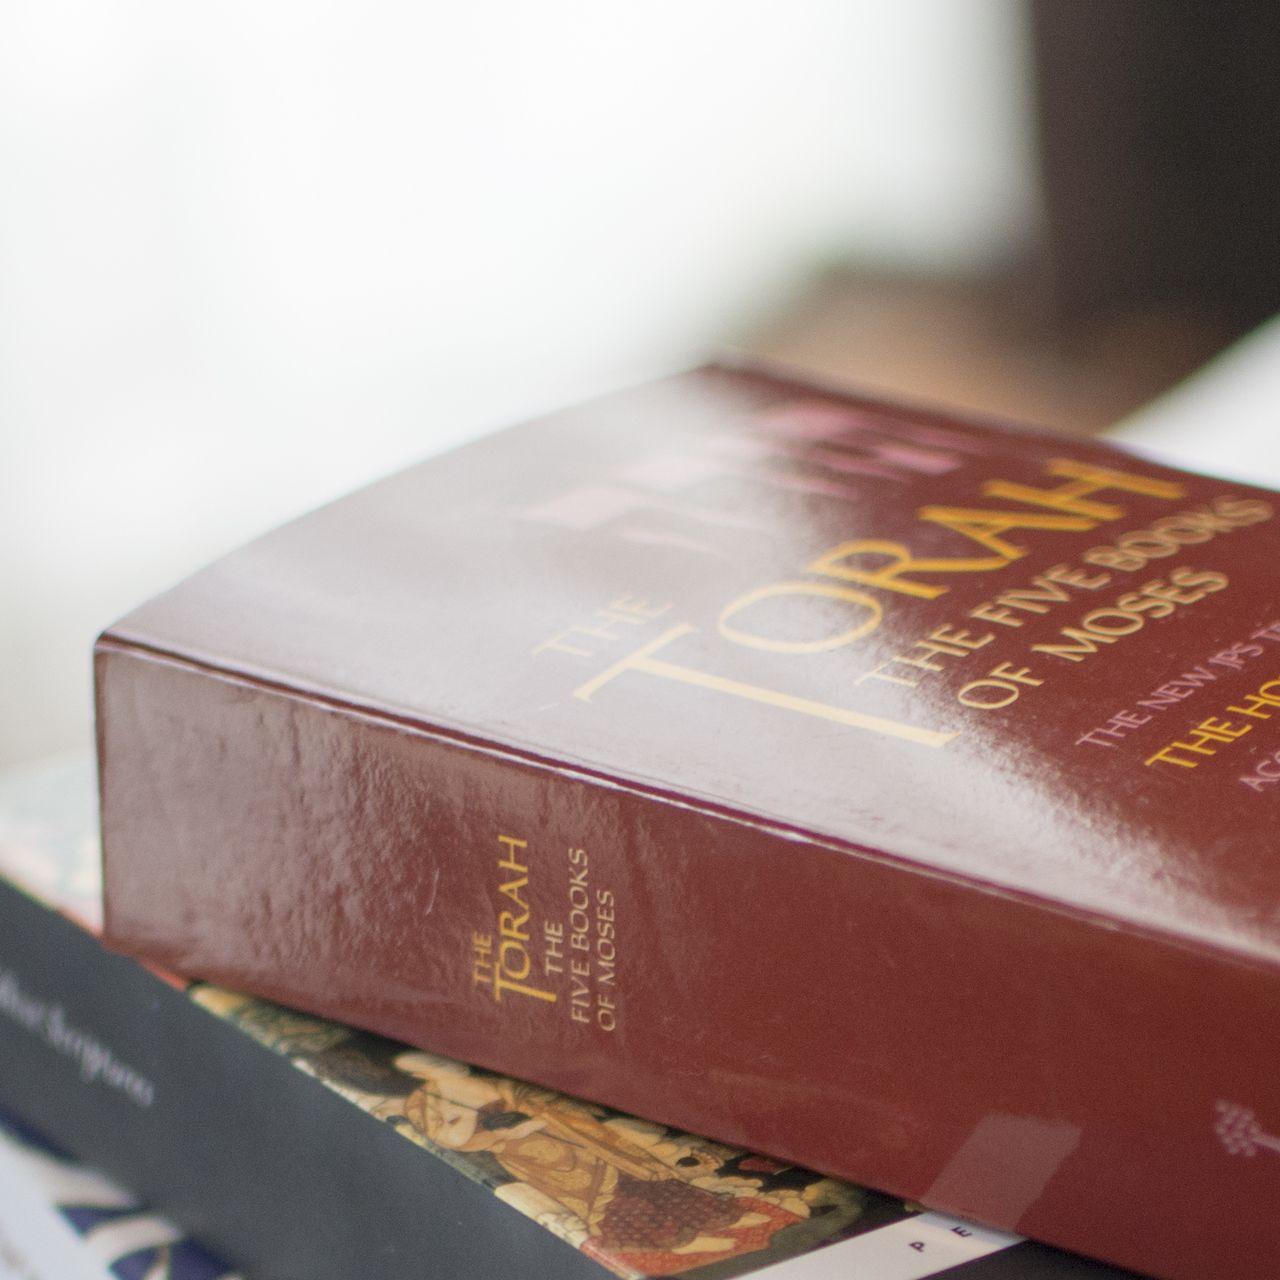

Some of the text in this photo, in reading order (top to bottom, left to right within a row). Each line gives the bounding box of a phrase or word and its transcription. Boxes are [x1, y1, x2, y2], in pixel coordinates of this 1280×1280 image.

[532, 593, 674, 658] THE
[573, 458, 1188, 748] TORAH
[853, 496, 1275, 688] THE FIVE BOOKS
[957, 566, 1230, 710] OF MOSES
[1074, 709, 1154, 749] THE
[1136, 665, 1218, 712] NEW
[1143, 715, 1254, 769] THE
[472, 930, 493, 987] THE
[494, 834, 558, 1004] TORAH
[544, 919, 564, 977] THE
[568, 847, 591, 1024] FIVE BOOKS
[596, 889, 617, 1032] OF MOSES
